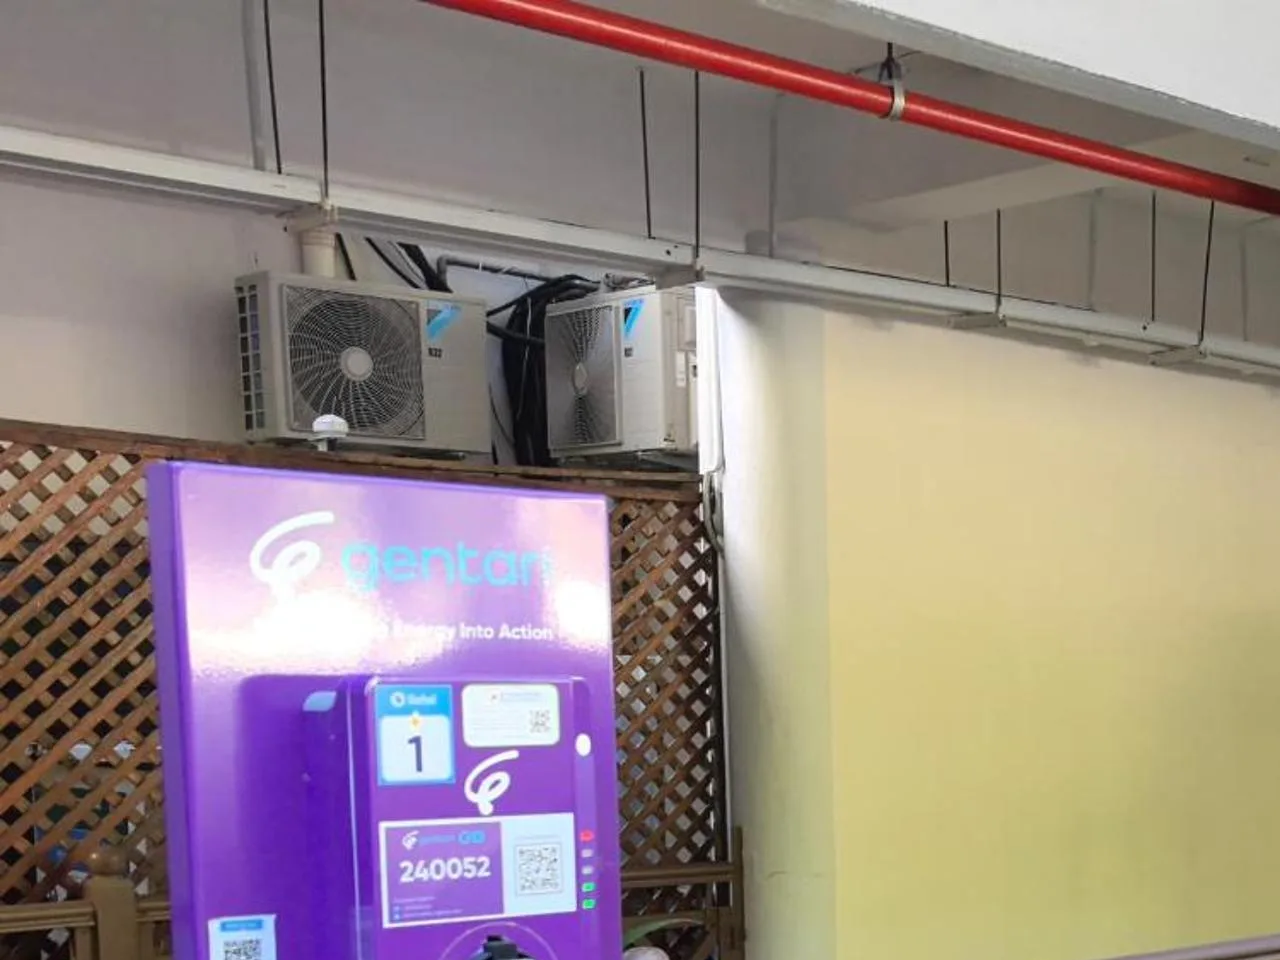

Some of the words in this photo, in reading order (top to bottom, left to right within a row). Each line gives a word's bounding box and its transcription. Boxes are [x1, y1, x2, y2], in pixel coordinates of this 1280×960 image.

[460, 622, 494, 640] Into
[500, 622, 554, 641] Action
[408, 735, 423, 773] 1
[399, 856, 492, 882] 240052
